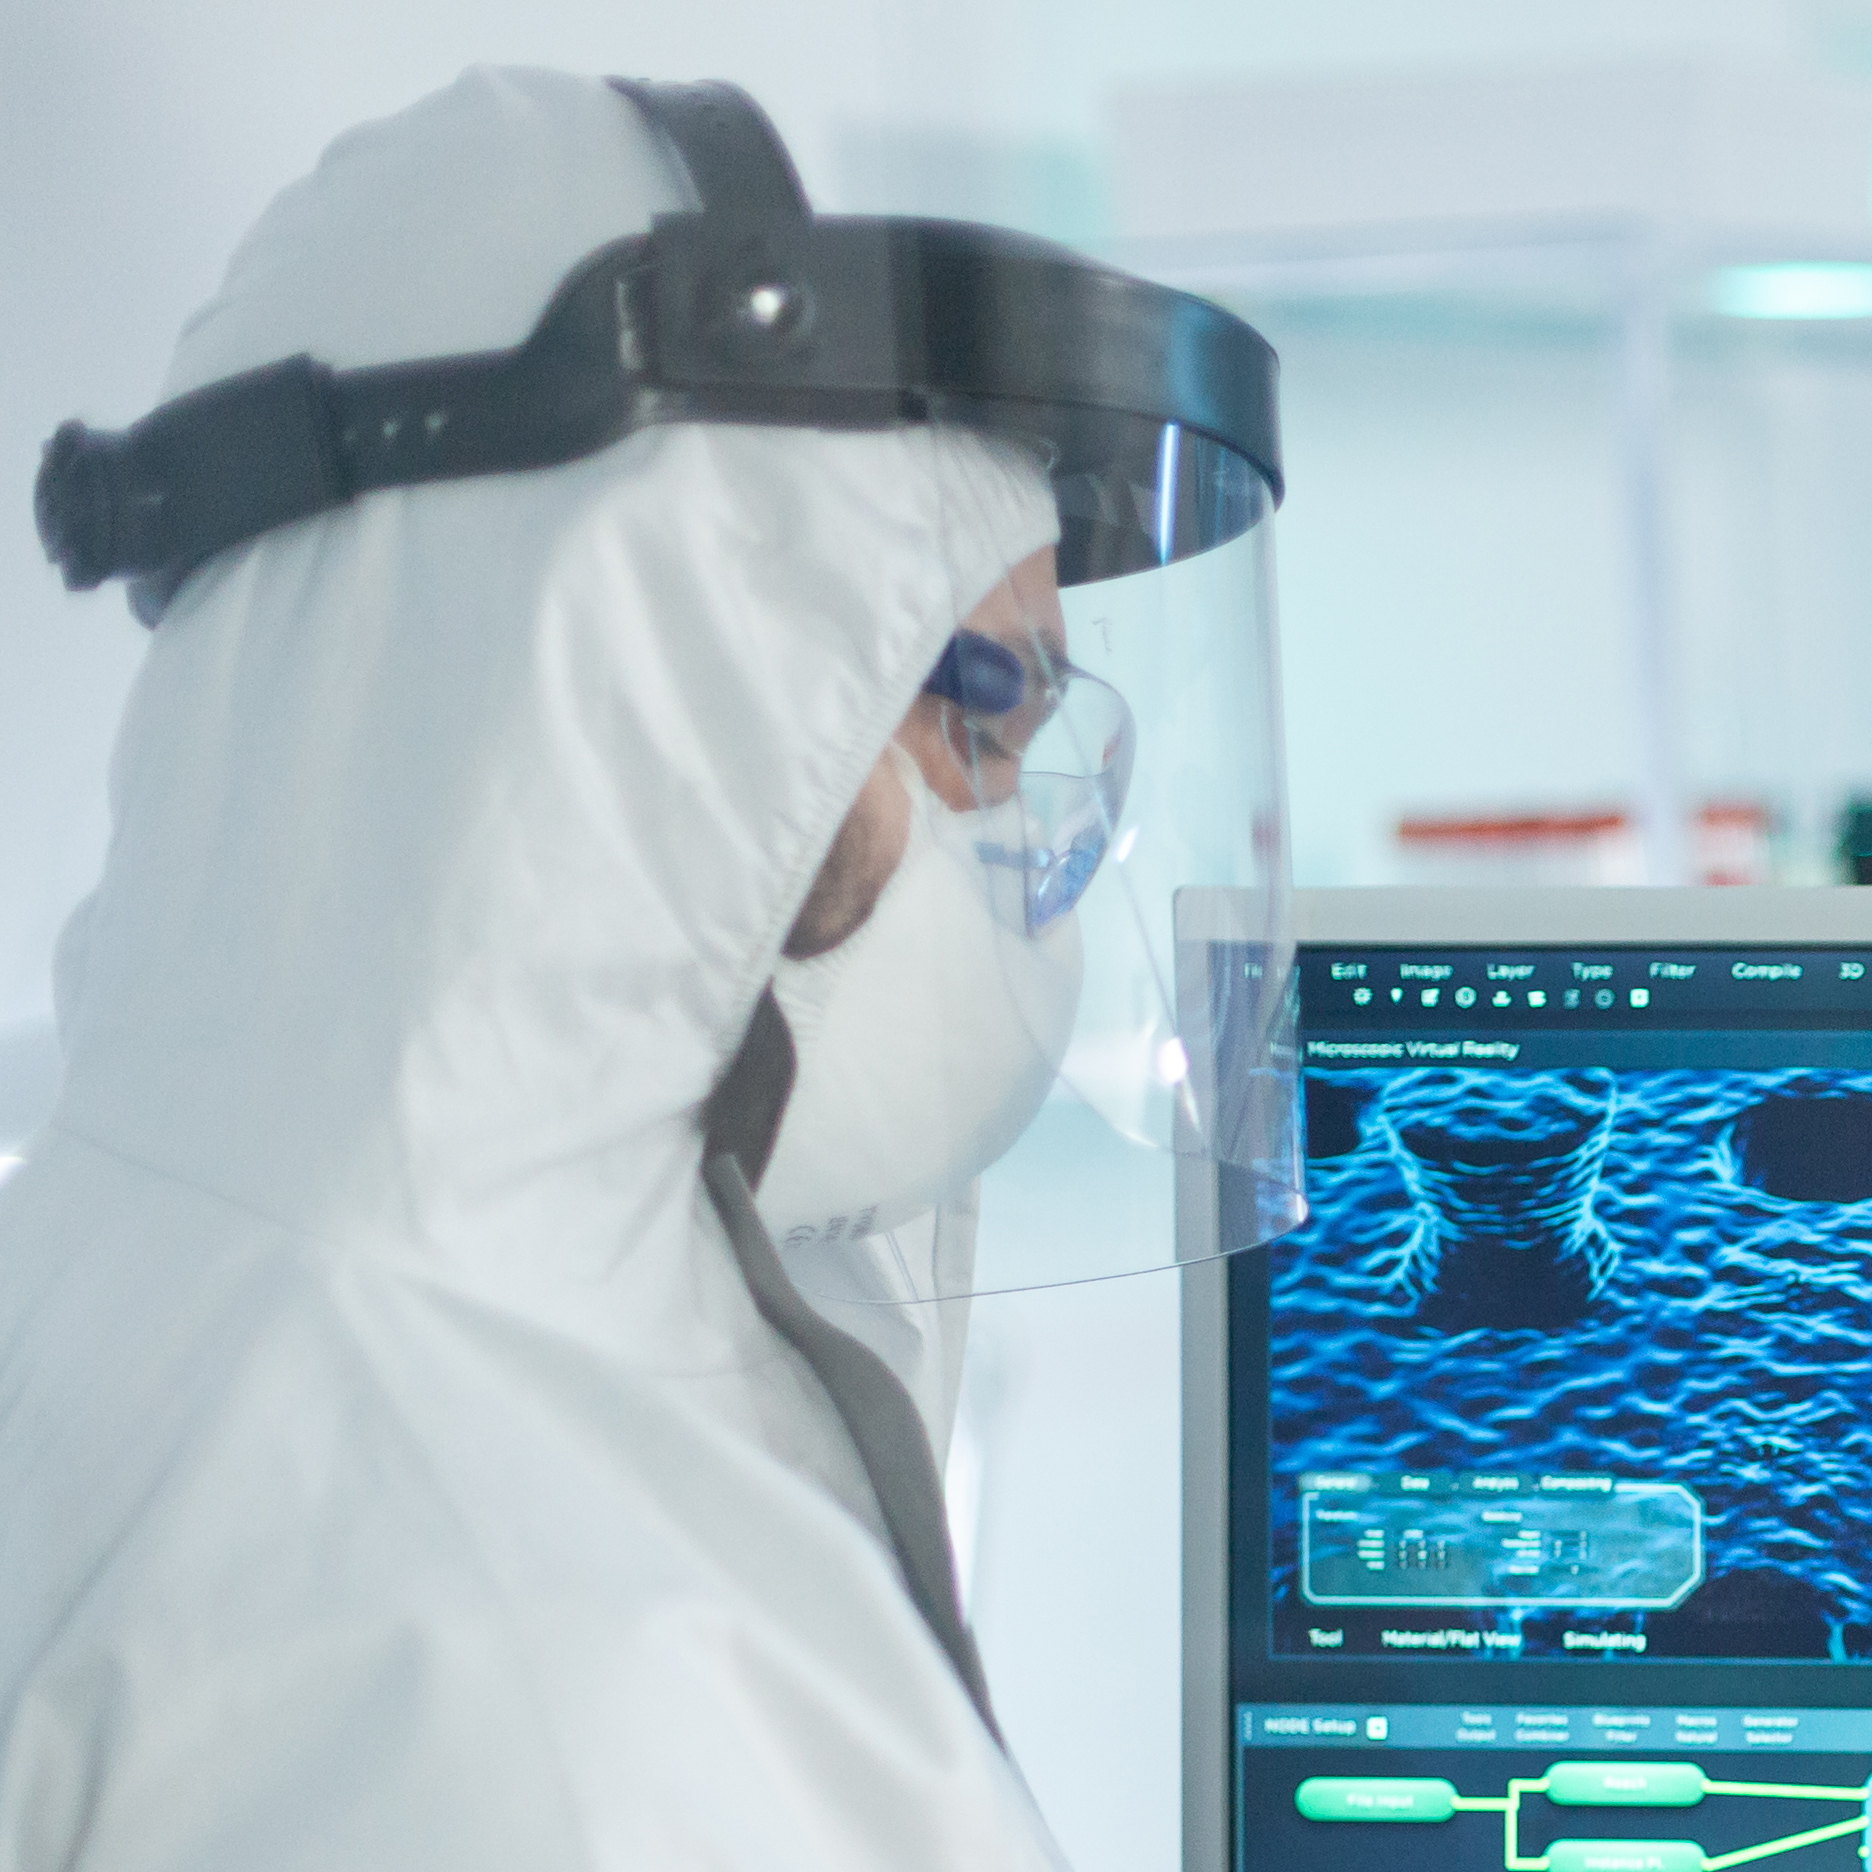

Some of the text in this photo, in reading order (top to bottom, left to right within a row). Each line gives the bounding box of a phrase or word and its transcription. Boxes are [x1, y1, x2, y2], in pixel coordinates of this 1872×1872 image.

[1330, 963, 1368, 979] Edit
[1399, 963, 1453, 982] Image
[1486, 963, 1535, 982] Layer
[1571, 963, 1615, 981] Type
[1649, 963, 1697, 980] Filter
[1730, 962, 1803, 981] Compile
[1839, 962, 1866, 981] 3D
[1307, 1040, 1521, 1062] Microscopic Virtual Reality
[1308, 1629, 1343, 1647] Tool
[1482, 1629, 1522, 1649] View
[1563, 1631, 1646, 1653] Simulating
[1312, 1718, 1357, 1737] Setup
